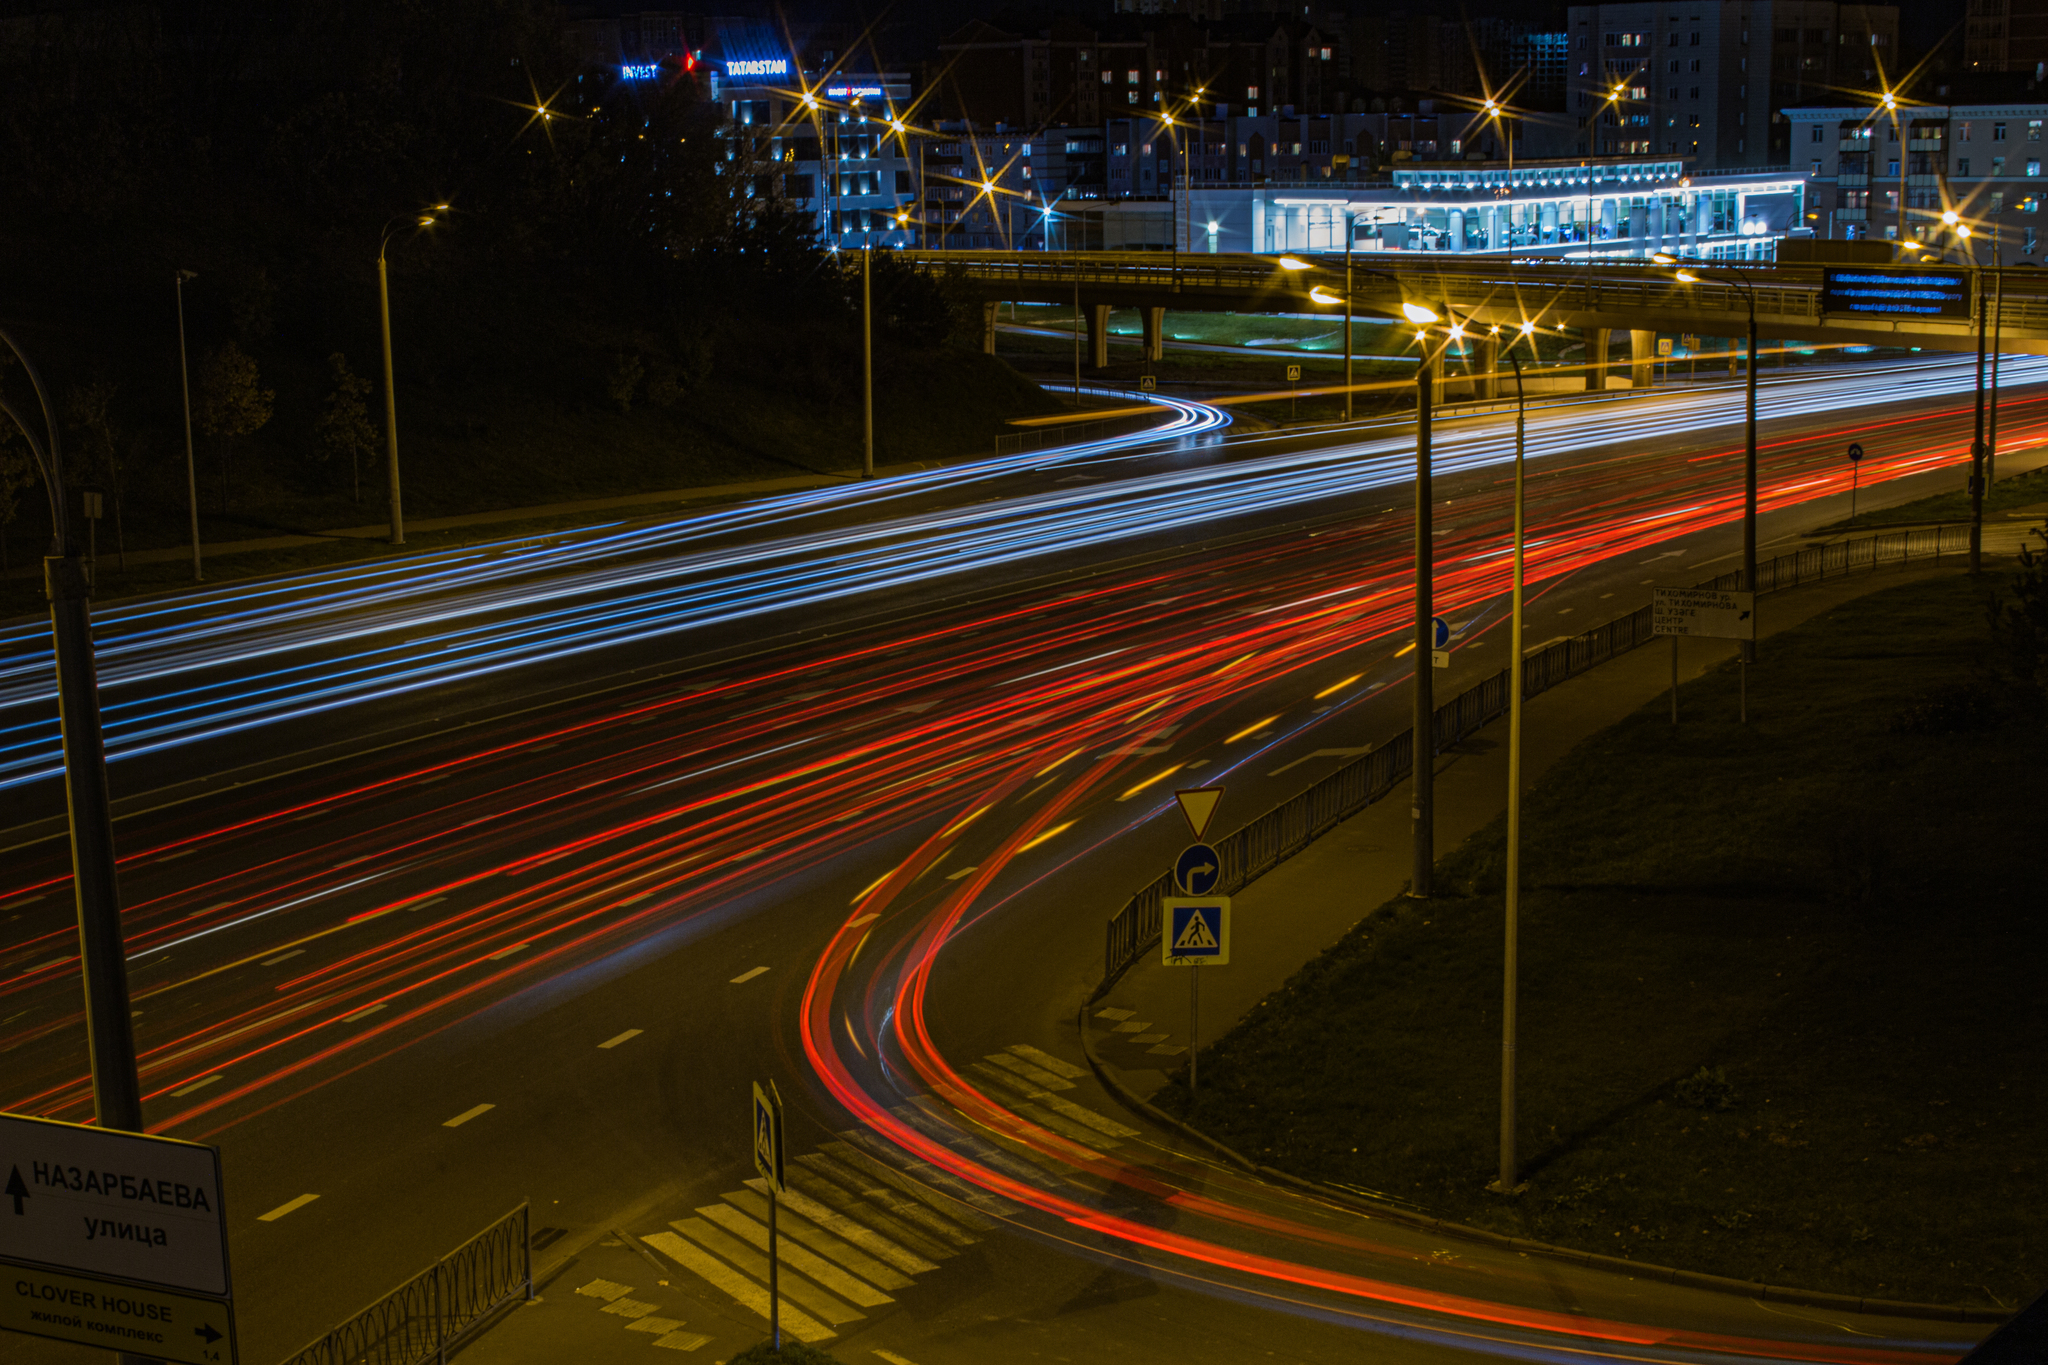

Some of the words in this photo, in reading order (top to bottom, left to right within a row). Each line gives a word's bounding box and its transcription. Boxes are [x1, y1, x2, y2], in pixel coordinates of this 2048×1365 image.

[726, 60, 787, 76] TATARSTAN
[1655, 589, 1717, 599] ТИХОМИРНОВ
[1669, 598, 1737, 610] ТИХОМИРНОВА
[1655, 626, 1688, 634] CENTRE
[33, 1161, 210, 1212] НАЗАРБАЕВА
[84, 1217, 167, 1247] улица
[16, 1280, 96, 1309] CLOVER
[103, 1296, 172, 1323] HOUSE
[31, 1310, 82, 1328] жилой
[87, 1320, 164, 1343] комплекс
[203, 1350, 219, 1361] 1,4
